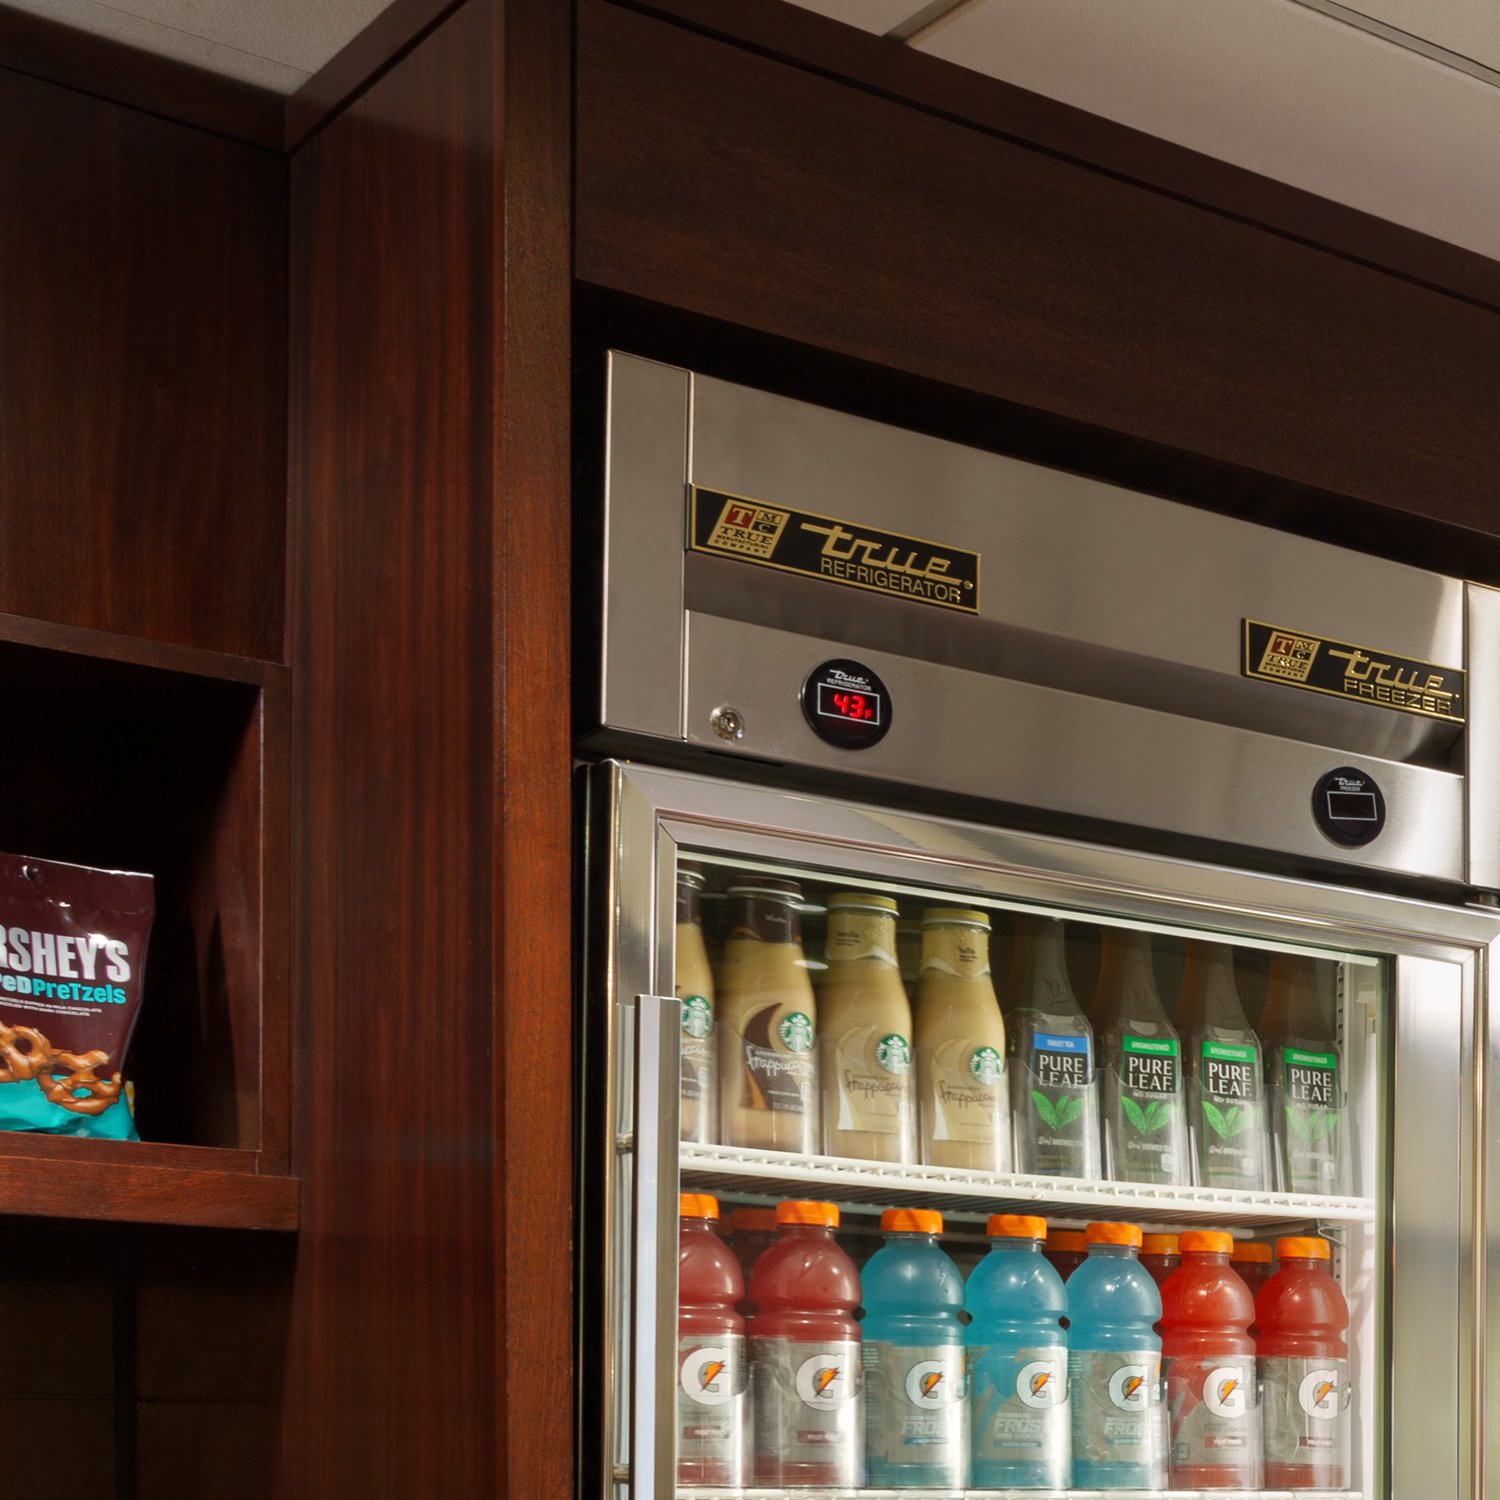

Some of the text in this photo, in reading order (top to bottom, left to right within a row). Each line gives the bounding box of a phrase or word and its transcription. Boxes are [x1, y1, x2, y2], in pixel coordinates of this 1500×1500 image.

[720, 526, 772, 545] TRUE
[801, 522, 962, 585] true
[820, 557, 961, 604] REFRIGERATOR
[1328, 651, 1453, 698] true
[827, 678, 871, 691] REFRIGERATOR
[1344, 679, 1451, 714] FREEZER
[1131, 1041, 1169, 1051] UNSWEETENED
[1039, 1055, 1083, 1073] PURE
[1128, 1057, 1172, 1076] PURE
[1208, 1062, 1251, 1081] PURE
[1039, 1071, 1083, 1088] LEAF
[1129, 1073, 1172, 1091] LEAF
[1209, 1078, 1251, 1096] LEAF
[1291, 1068, 1332, 1087] PURE
[1292, 1084, 1332, 1102] LEAF
[681, 1348, 746, 1405] G
[796, 1354, 861, 1411] G
[905, 1360, 968, 1409] G
[1203, 1366, 1255, 1418] G
[1299, 1370, 1348, 1419] G
